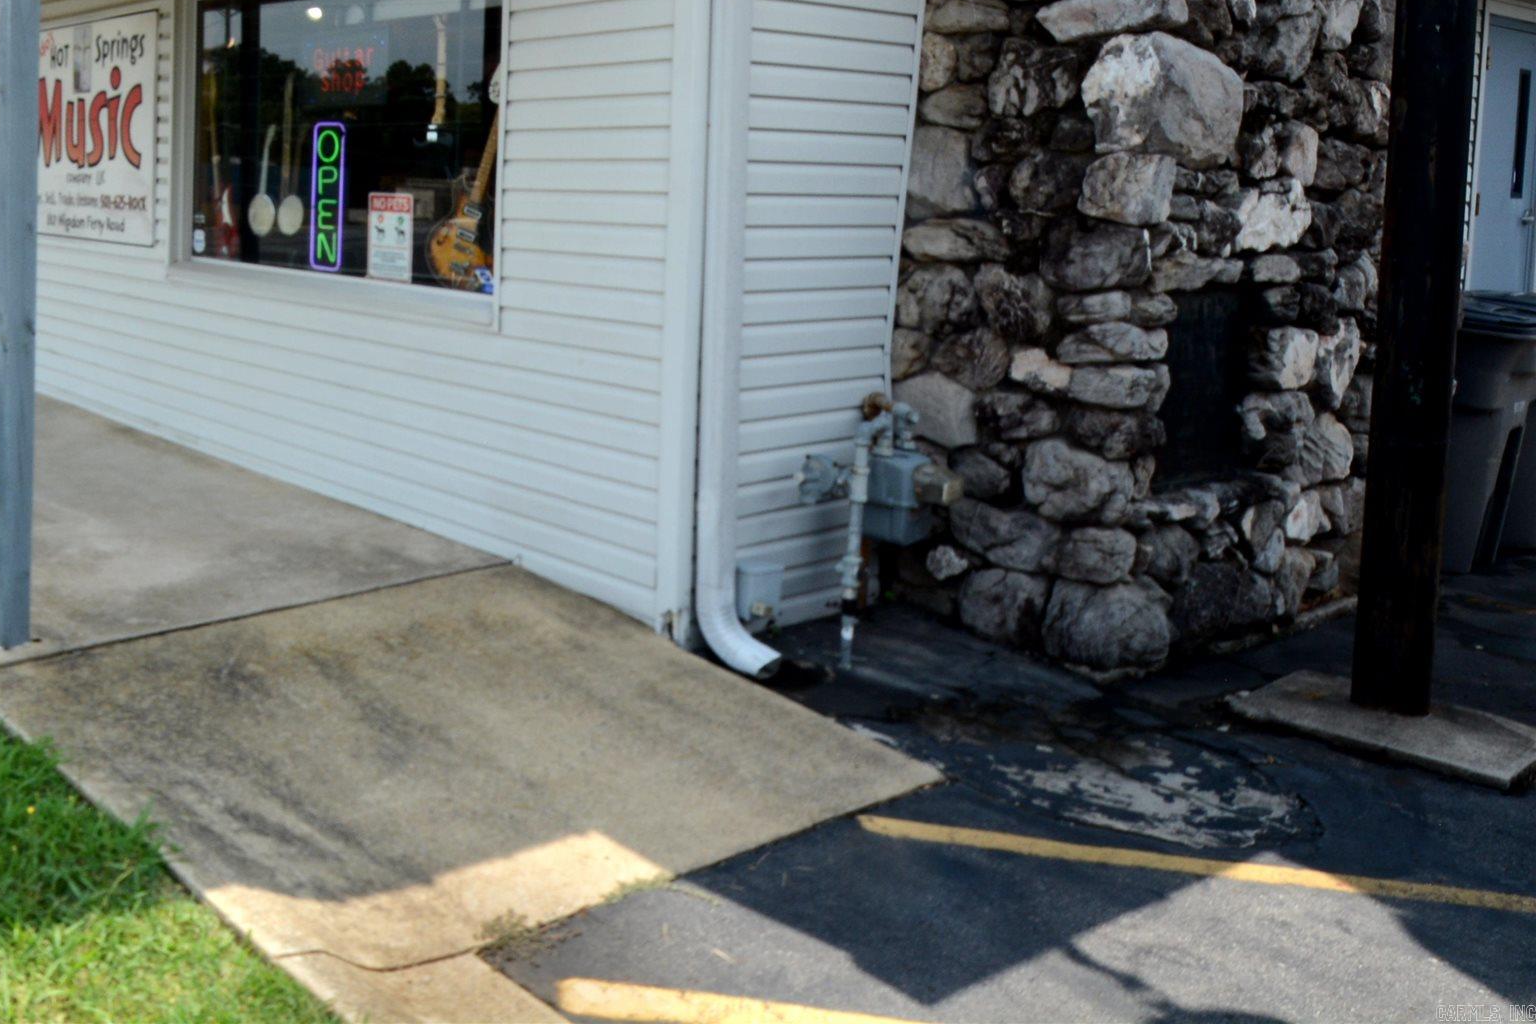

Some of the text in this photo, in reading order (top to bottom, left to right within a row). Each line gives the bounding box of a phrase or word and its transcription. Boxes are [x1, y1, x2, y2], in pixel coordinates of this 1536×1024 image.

[94, 29, 145, 67] Springs
[38, 65, 142, 170] Music
[317, 129, 339, 264] OPEN
[372, 197, 409, 213] NO PETS
